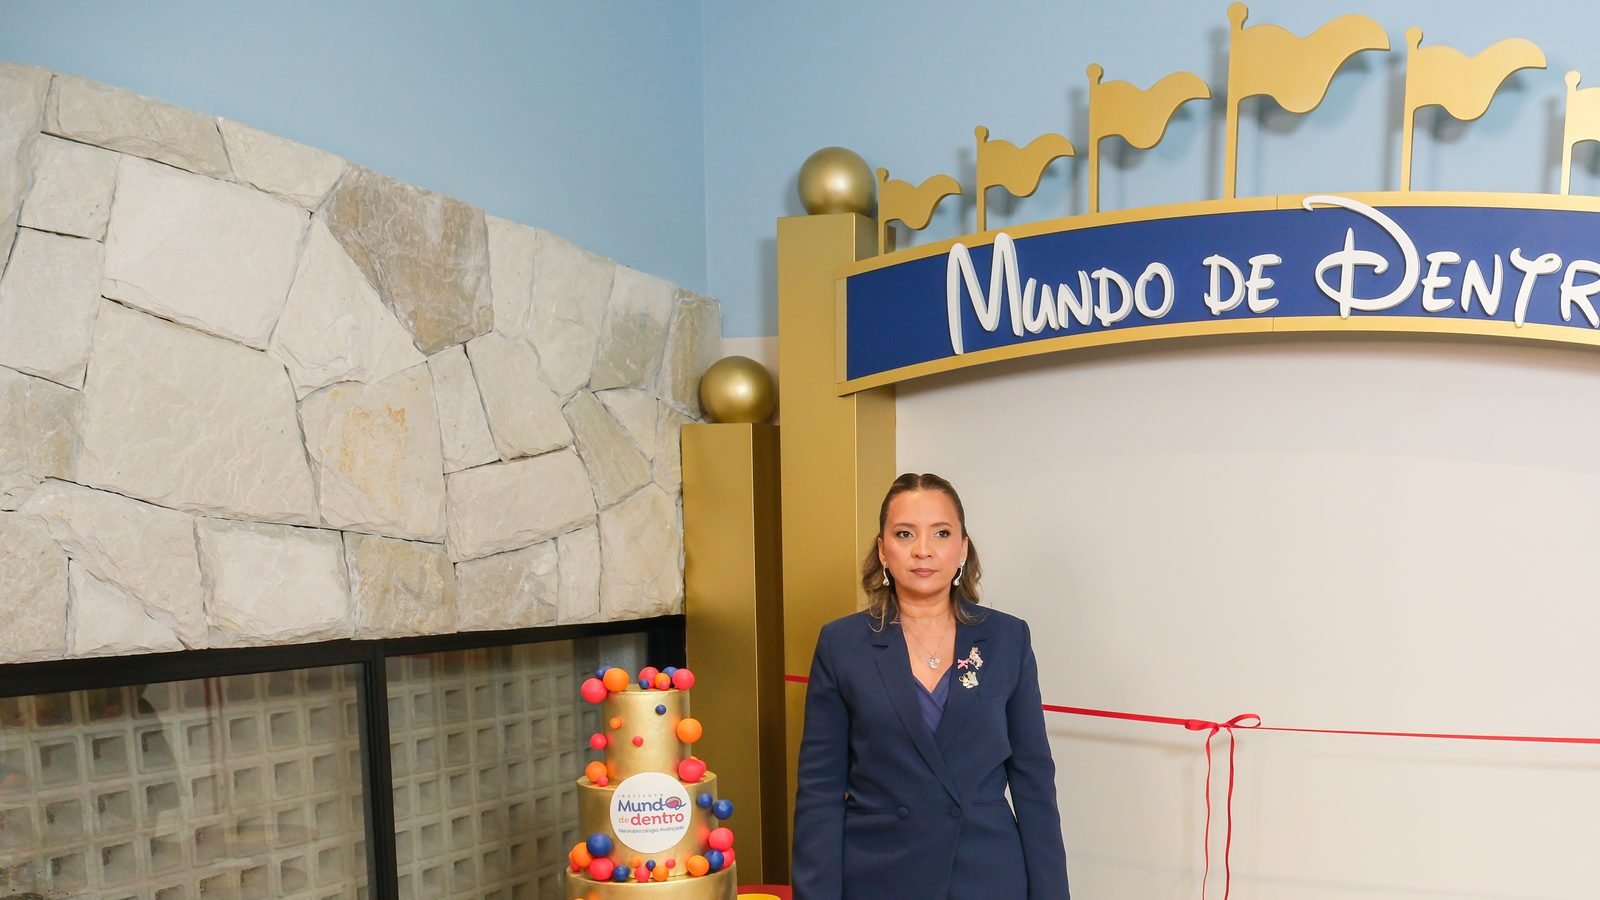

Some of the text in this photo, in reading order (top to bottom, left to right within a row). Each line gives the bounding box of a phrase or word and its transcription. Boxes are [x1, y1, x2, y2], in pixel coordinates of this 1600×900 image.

[1202, 253, 1283, 316] DE
[618, 812, 684, 826] de dentro
